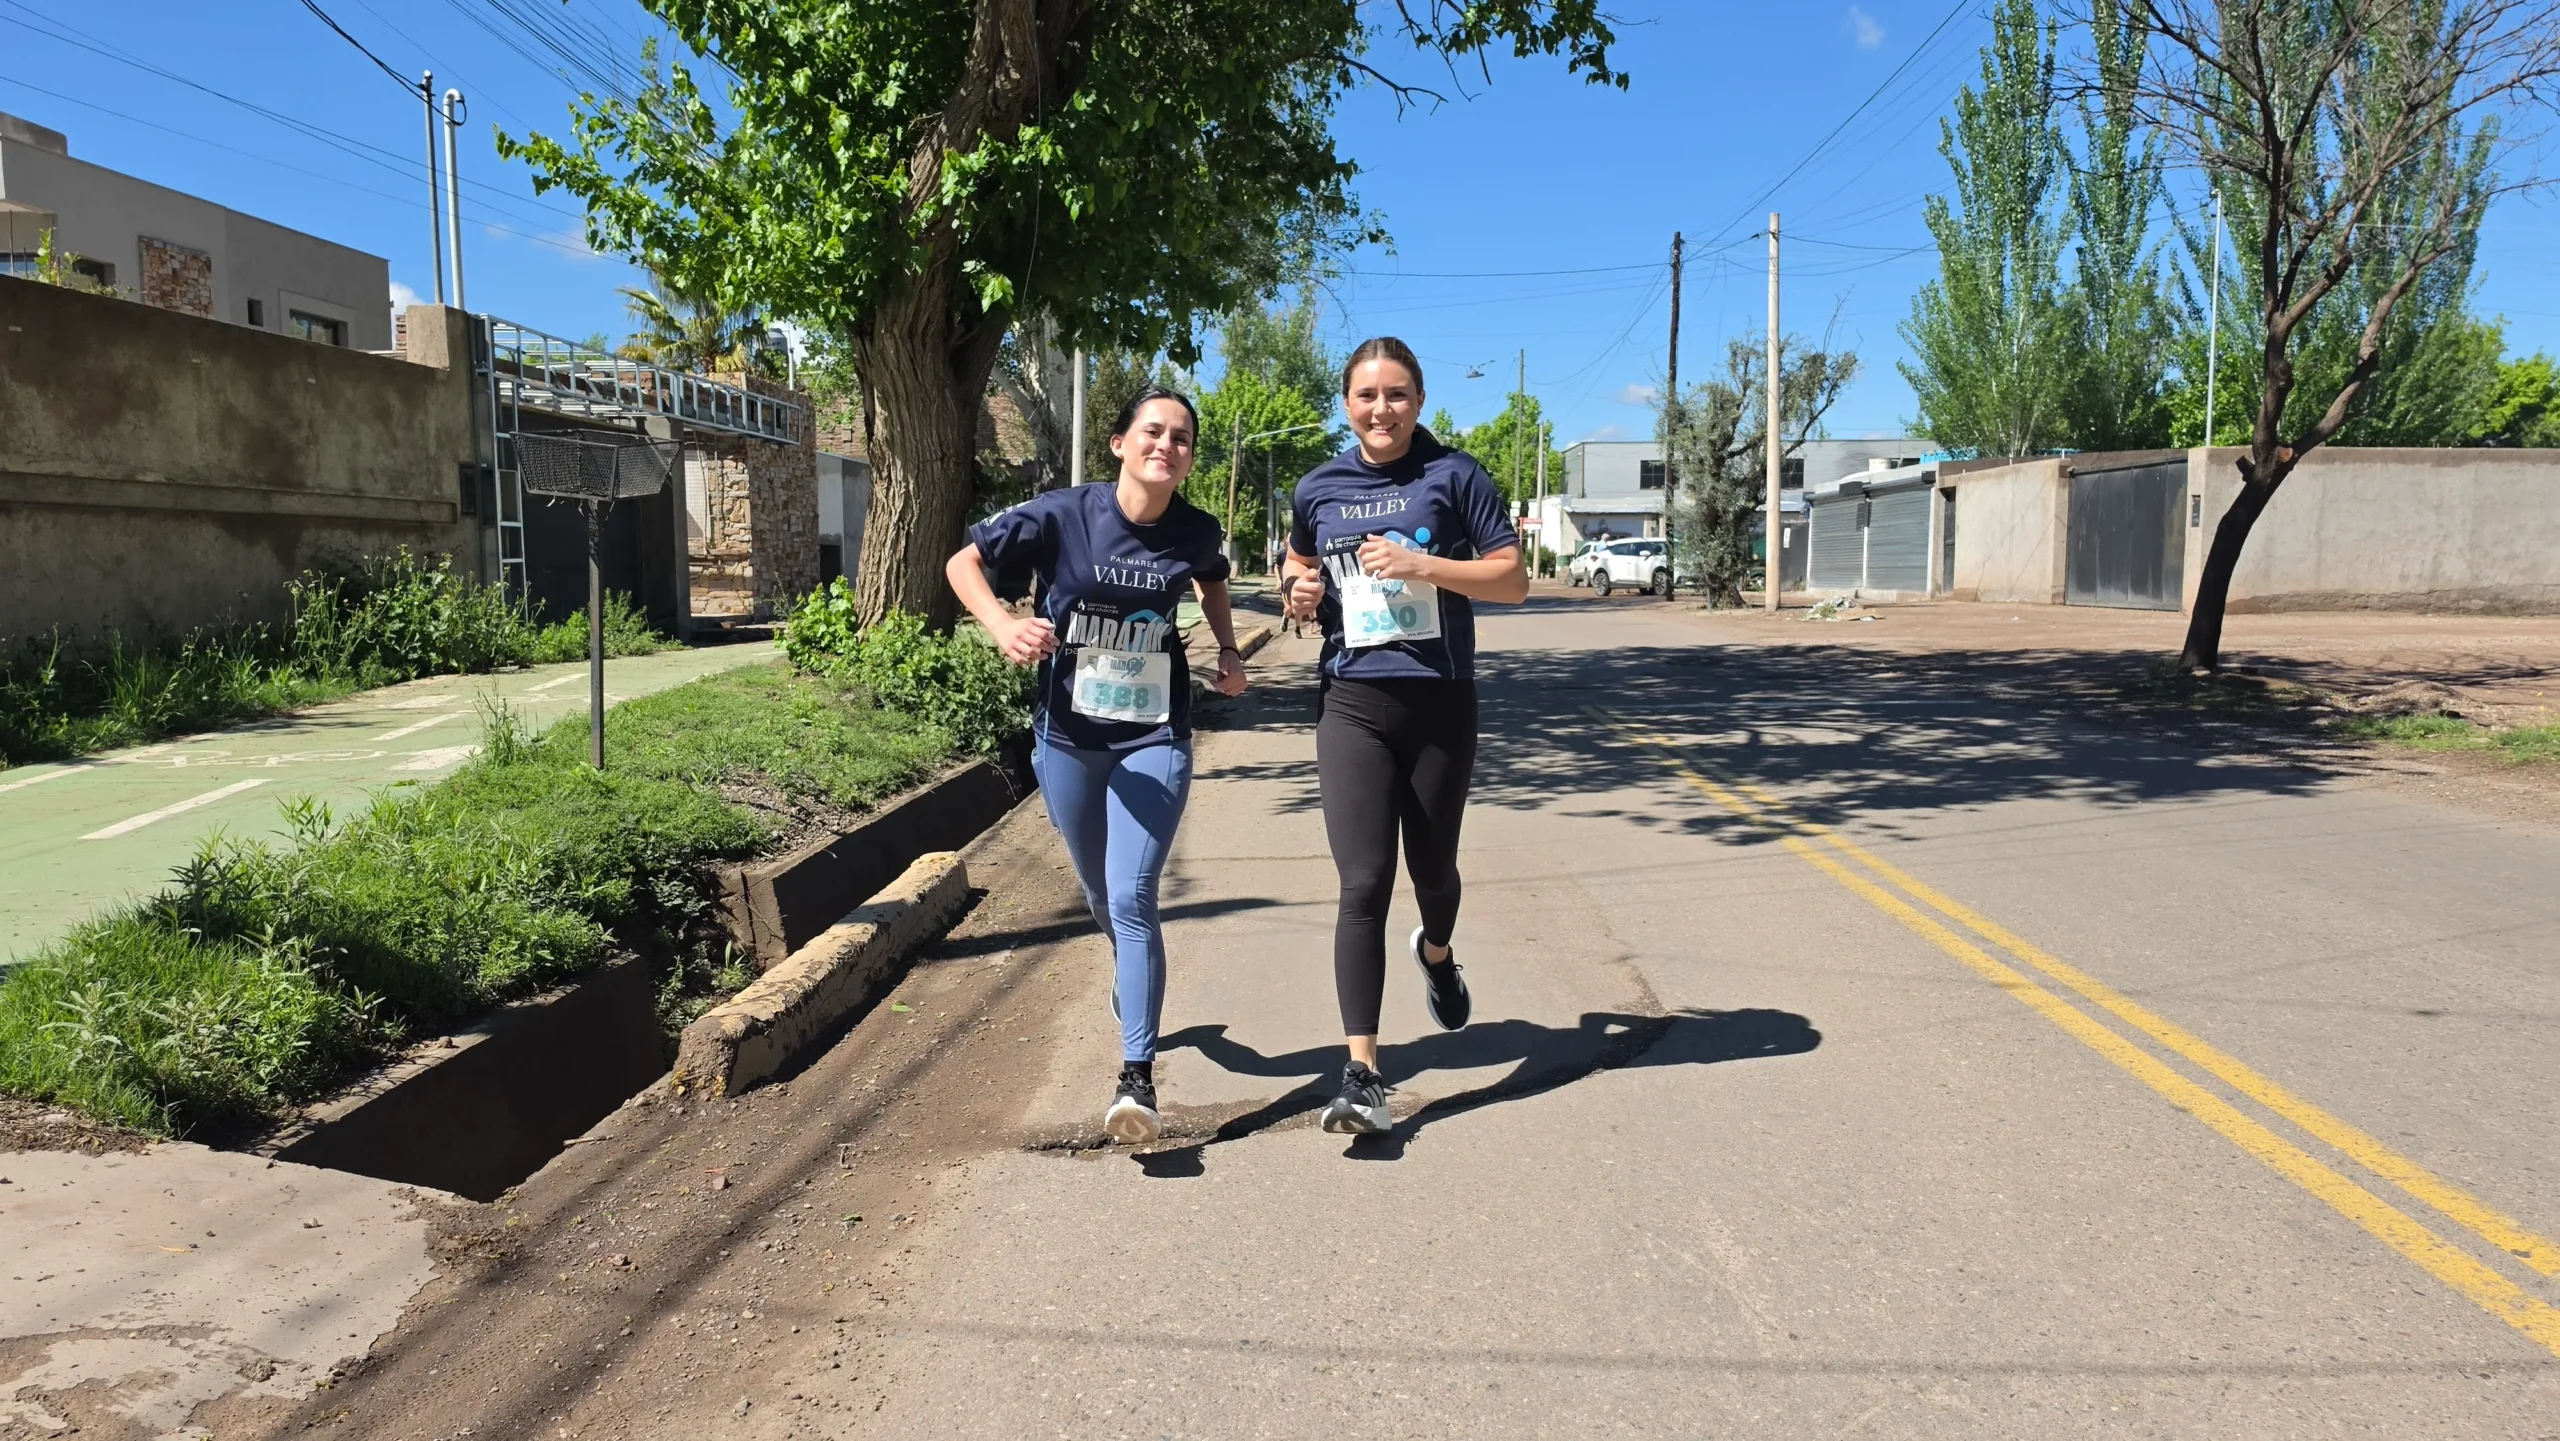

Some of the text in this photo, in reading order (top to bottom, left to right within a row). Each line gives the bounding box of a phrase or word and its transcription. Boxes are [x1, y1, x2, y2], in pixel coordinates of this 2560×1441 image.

[1354, 492, 1399, 500] PALMARES
[1340, 498, 1412, 520] VALLEY
[1334, 534, 1362, 544] parroquia
[1110, 555, 1158, 569] PALMARES
[1093, 565, 1172, 592] VALLEY
[1362, 605, 1417, 633] 390
[1093, 682, 1149, 709] 388
